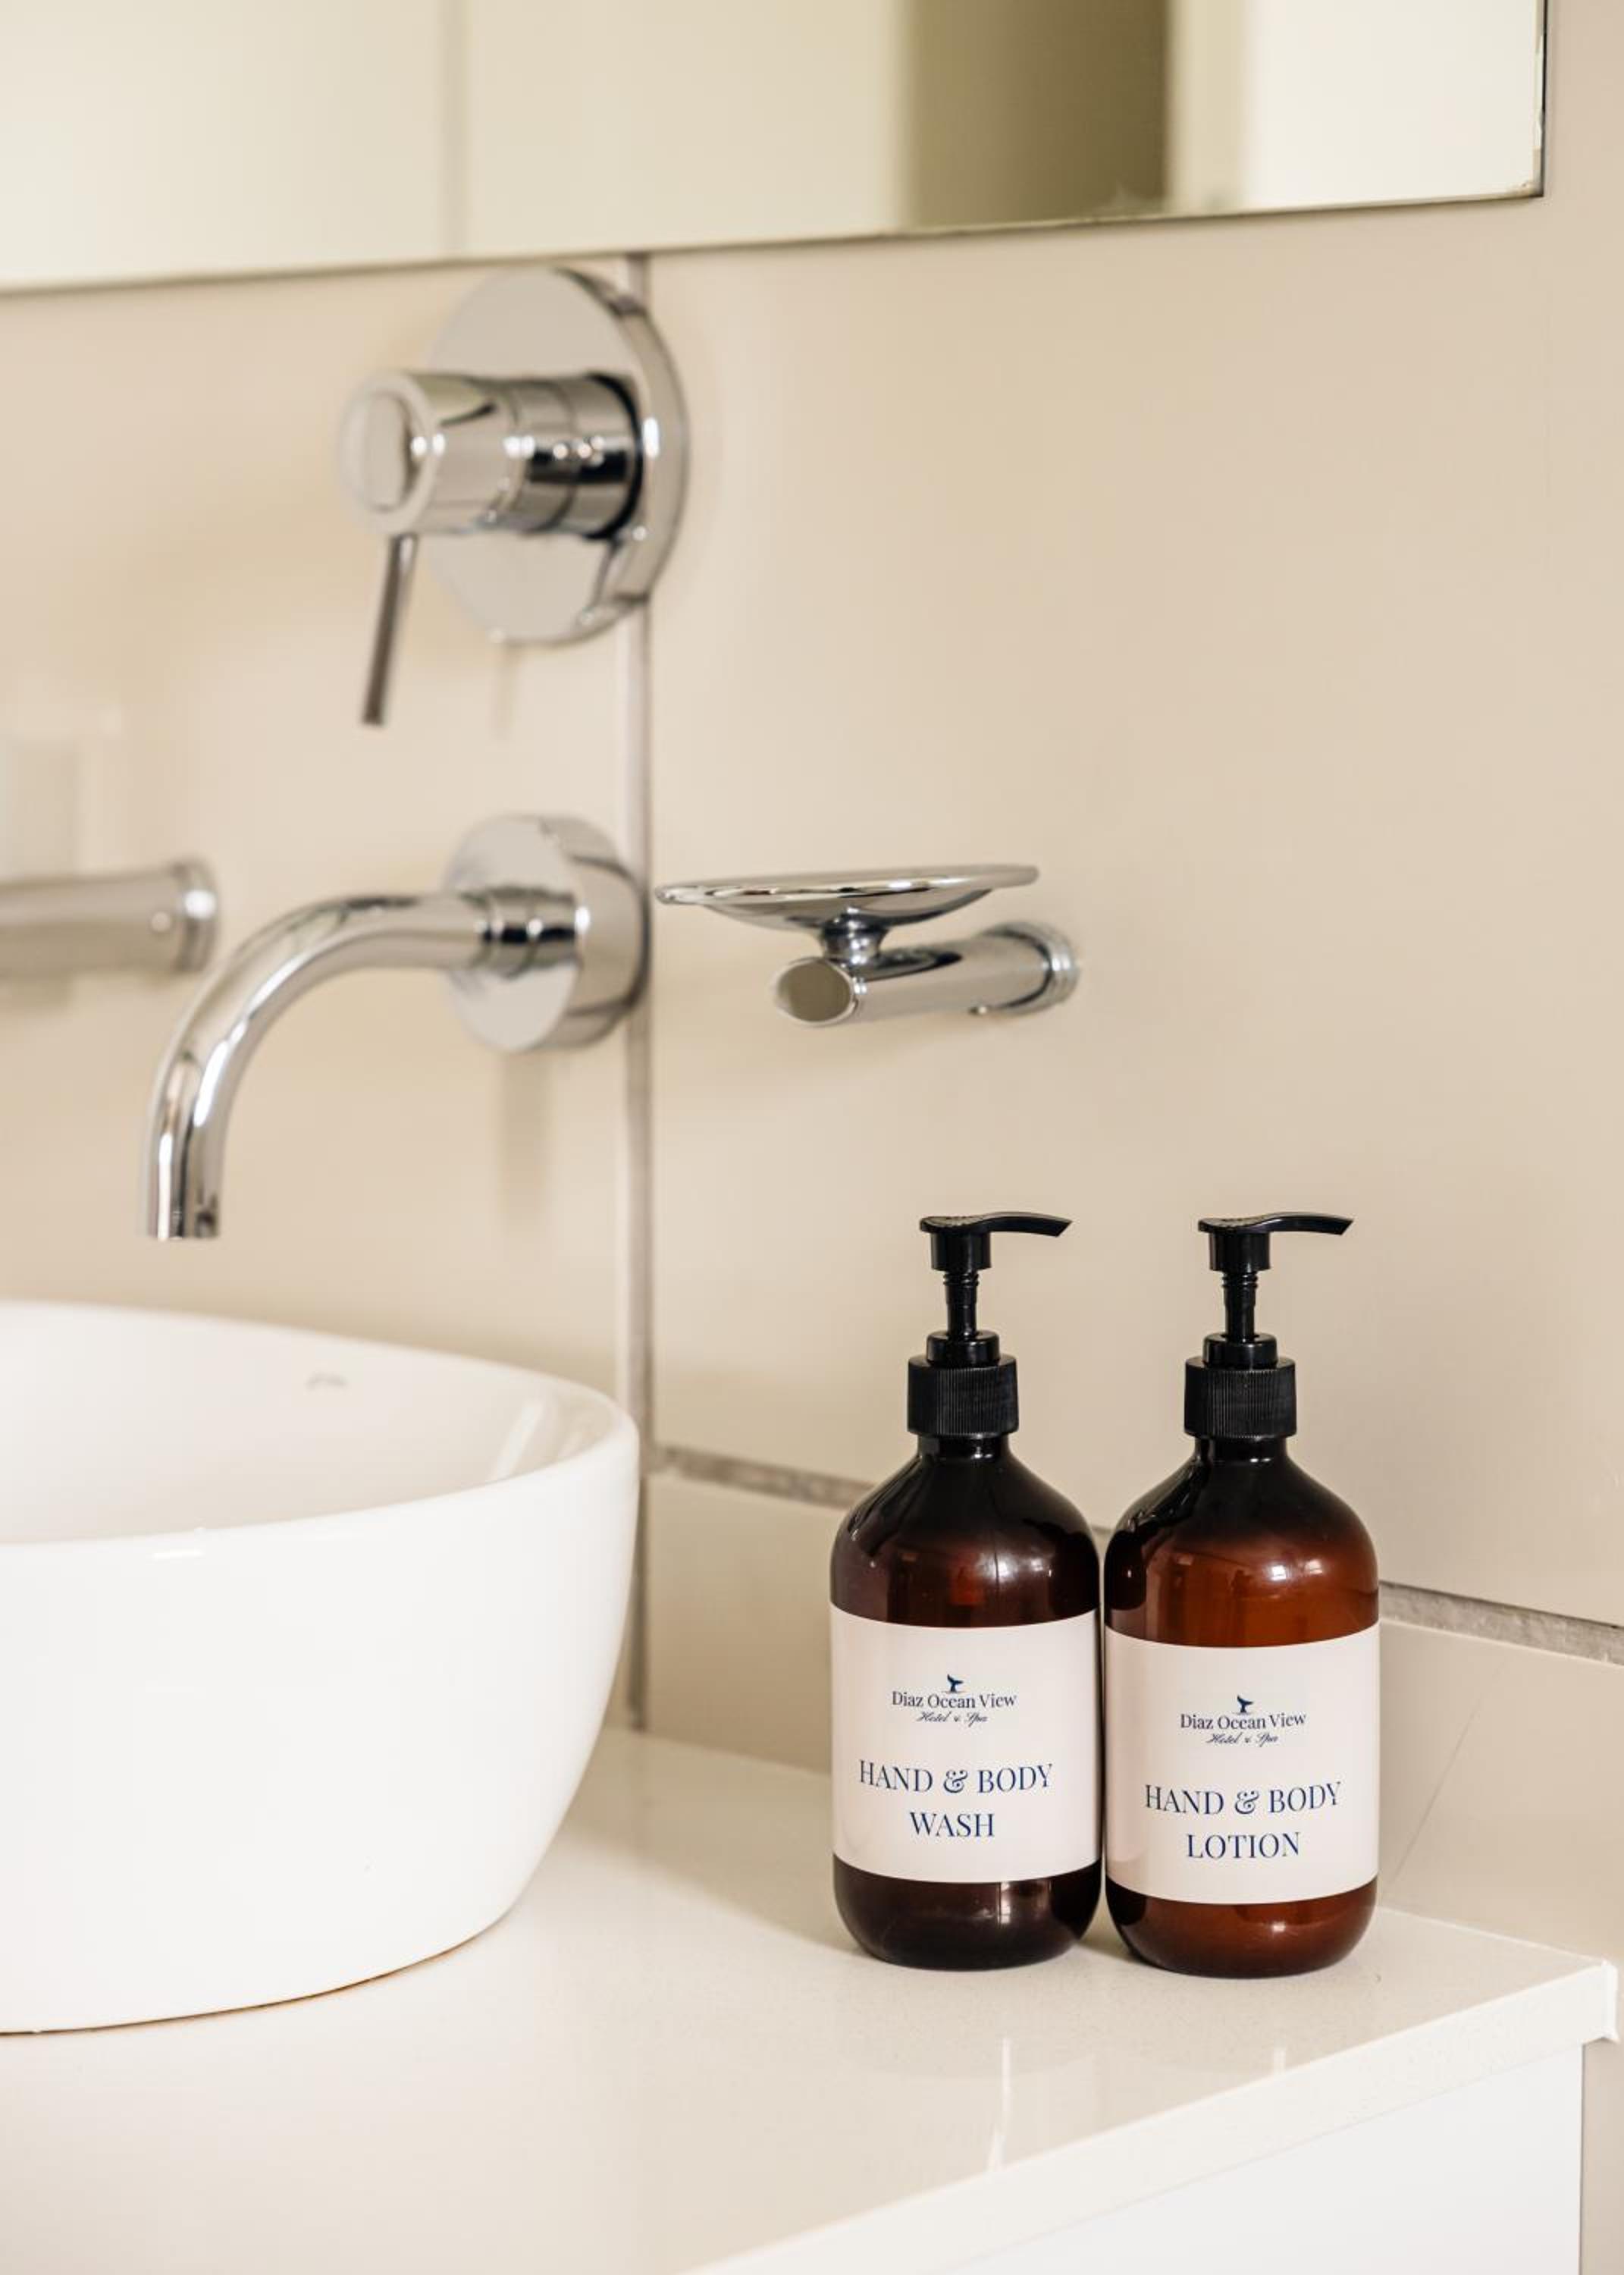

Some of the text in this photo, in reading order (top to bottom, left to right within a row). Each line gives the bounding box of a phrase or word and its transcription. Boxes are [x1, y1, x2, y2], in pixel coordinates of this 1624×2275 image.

[892, 1690, 1017, 1709] Diaz Ocean View
[916, 1711, 952, 1723] Hotel
[964, 1712, 989, 1728] Spa
[1180, 1712, 1306, 1730] Diaz Ocean View
[1205, 1732, 1243, 1744] Hotel
[1256, 1732, 1279, 1748] Spa
[859, 1759, 1053, 1794] HAND & BODY
[1145, 1781, 1341, 1815] HAND & BODY
[909, 1811, 995, 1837] WASH
[1186, 1831, 1300, 1859] LOTION
